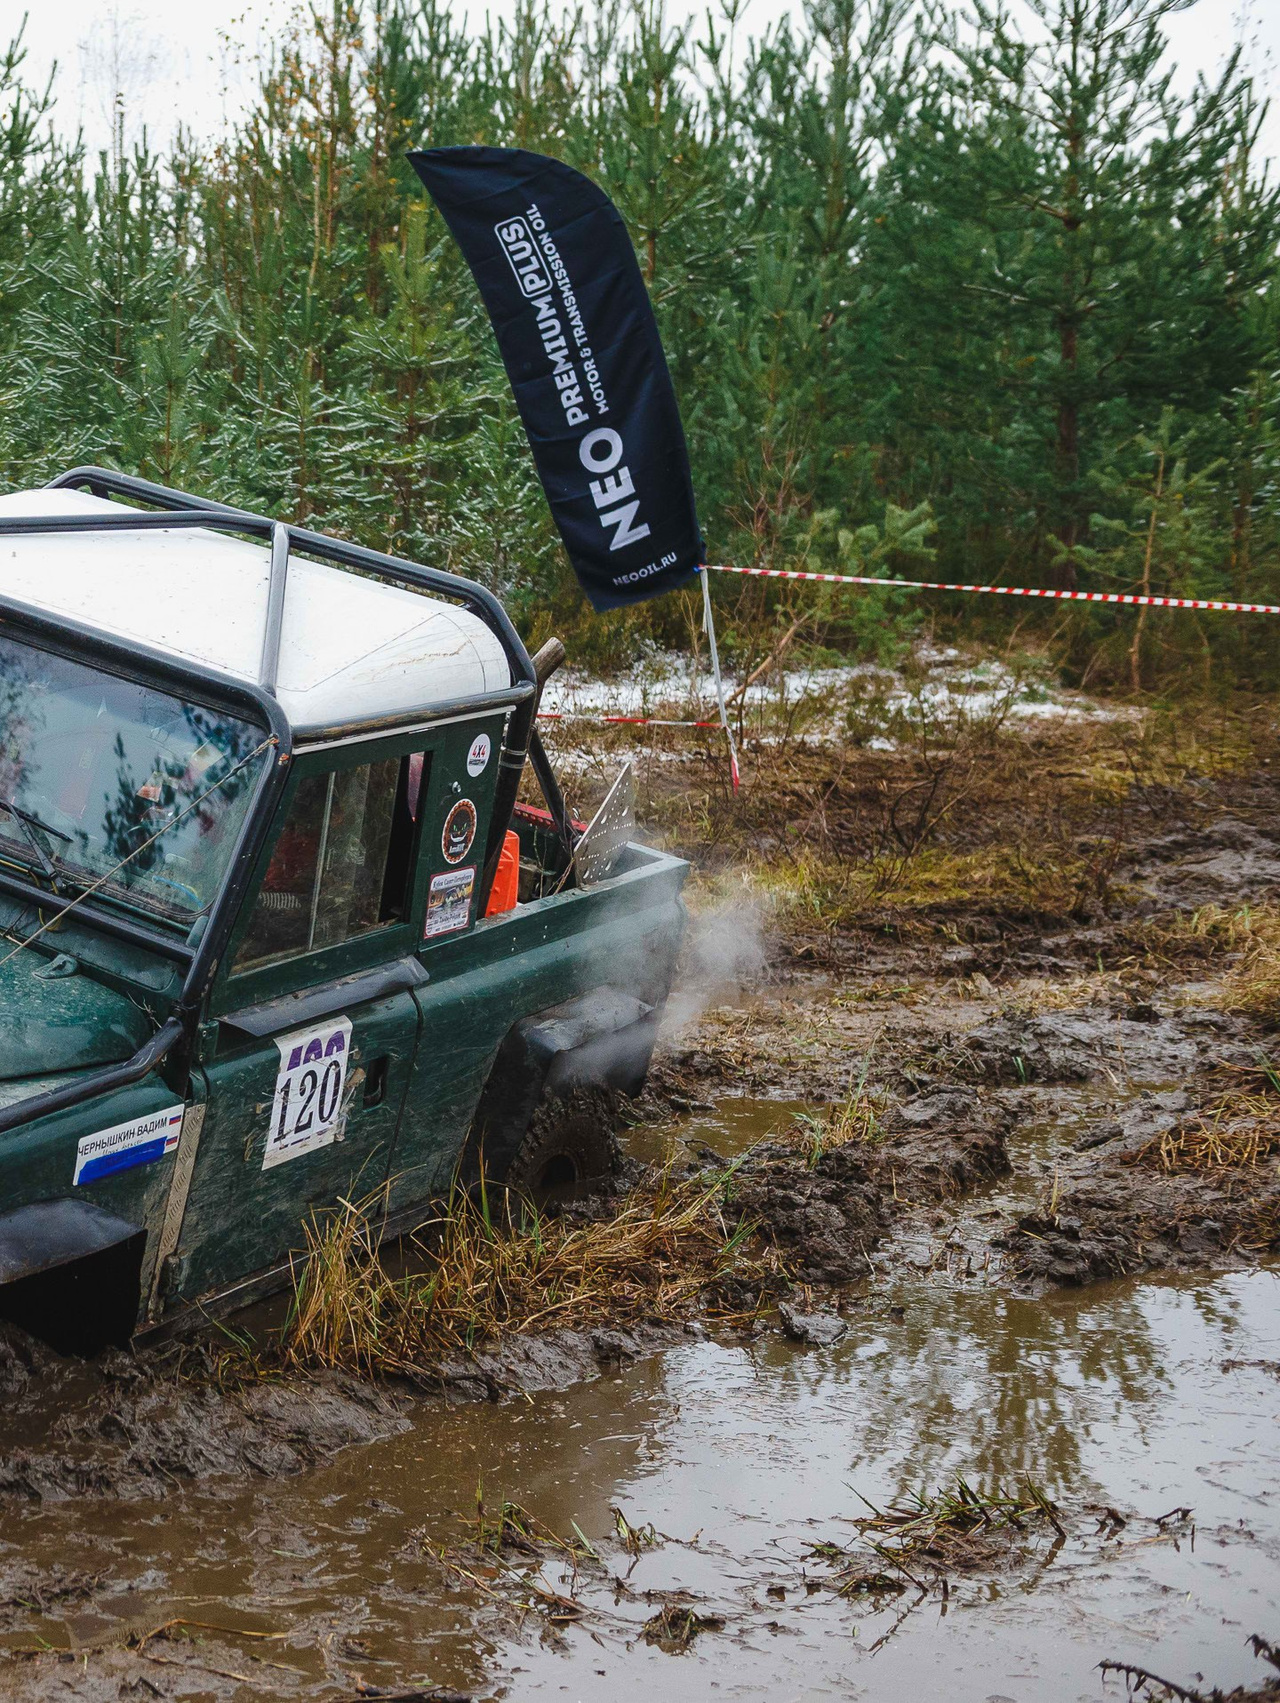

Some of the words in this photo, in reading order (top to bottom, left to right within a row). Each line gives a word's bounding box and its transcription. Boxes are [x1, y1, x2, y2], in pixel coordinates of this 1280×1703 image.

[526, 204, 546, 231] OIL
[501, 222, 547, 293] PLUS
[538, 231, 588, 347] TRANSMISSION
[531, 295, 589, 426] PREMIUM
[579, 347, 592, 358] &
[583, 358, 609, 414] MOTOR
[579, 427, 651, 551] NEO
[613, 552, 677, 586] NEOOIL.RU
[273, 1059, 342, 1144] 120
[78, 1126, 136, 1158] ЧЕРНЫШКИН
[137, 1116, 168, 1141] ВАДИМ
